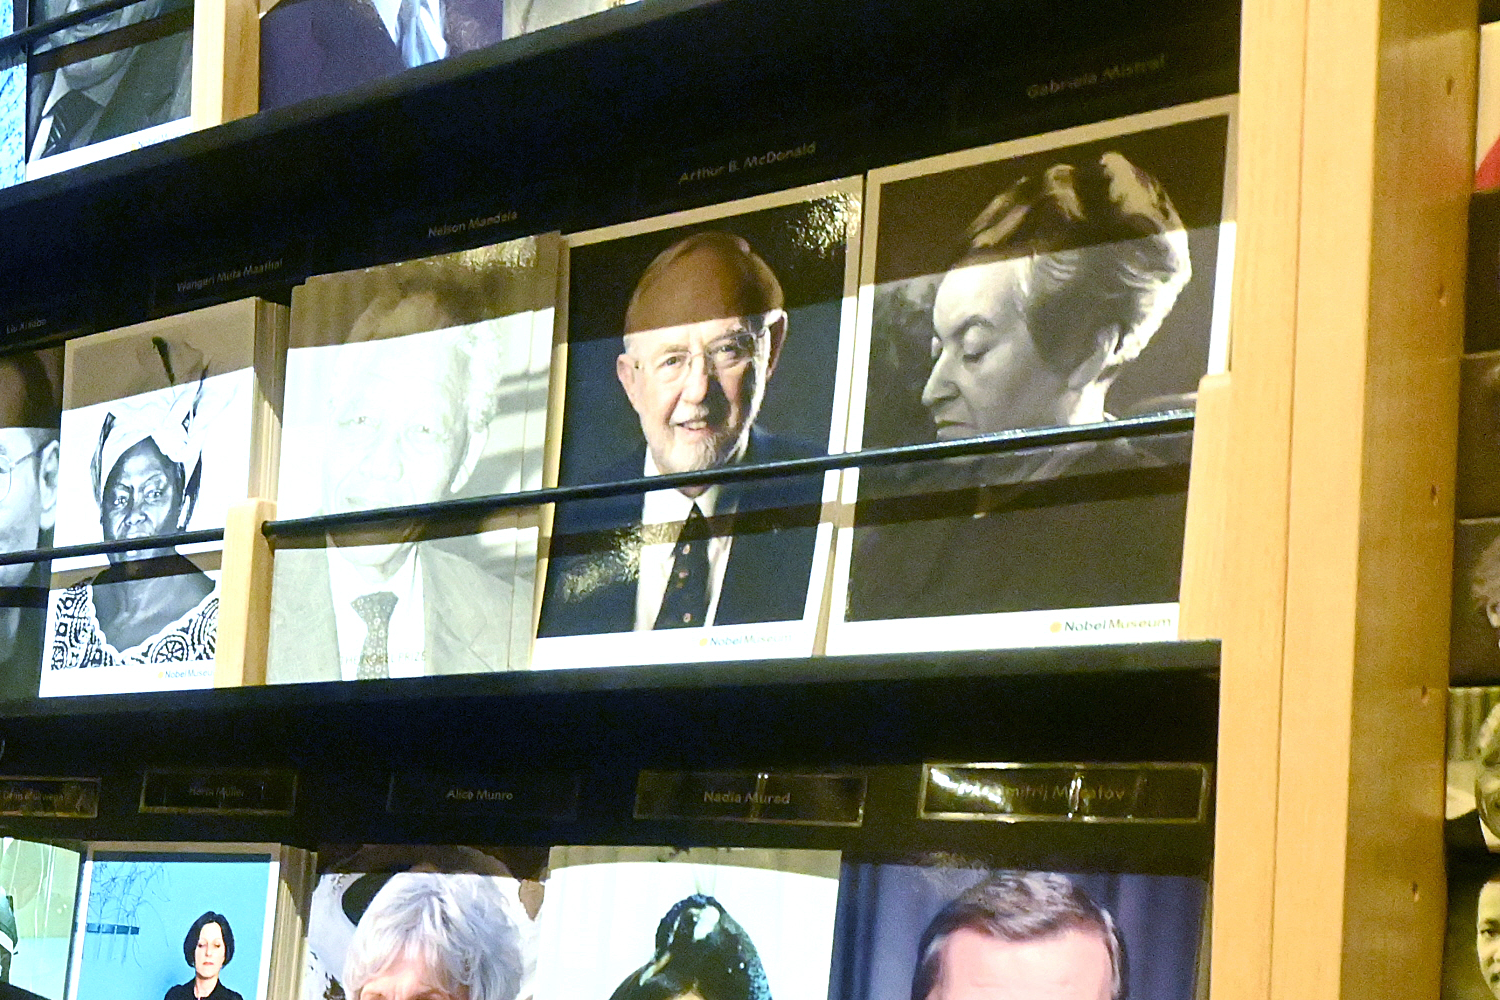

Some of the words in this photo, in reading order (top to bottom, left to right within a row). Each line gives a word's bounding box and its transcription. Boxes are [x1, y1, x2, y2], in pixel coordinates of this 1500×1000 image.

[677, 165, 725, 185] Arthur
[743, 141, 817, 168] McDonald
[427, 222, 467, 239] Nelson
[467, 210, 519, 231] Mandela
[1063, 615, 1173, 632] NobelMuseum
[708, 631, 793, 648] NobelMuseum
[398, 650, 427, 663] PRIZE
[164, 668, 214, 680] NobelMuseu
[445, 787, 475, 801] Alice
[476, 788, 514, 801] Munro
[703, 789, 742, 804] Nadia
[744, 790, 791, 805] Murad
[993, 784, 1048, 802] mitrij
[1052, 784, 1126, 801] Matov
